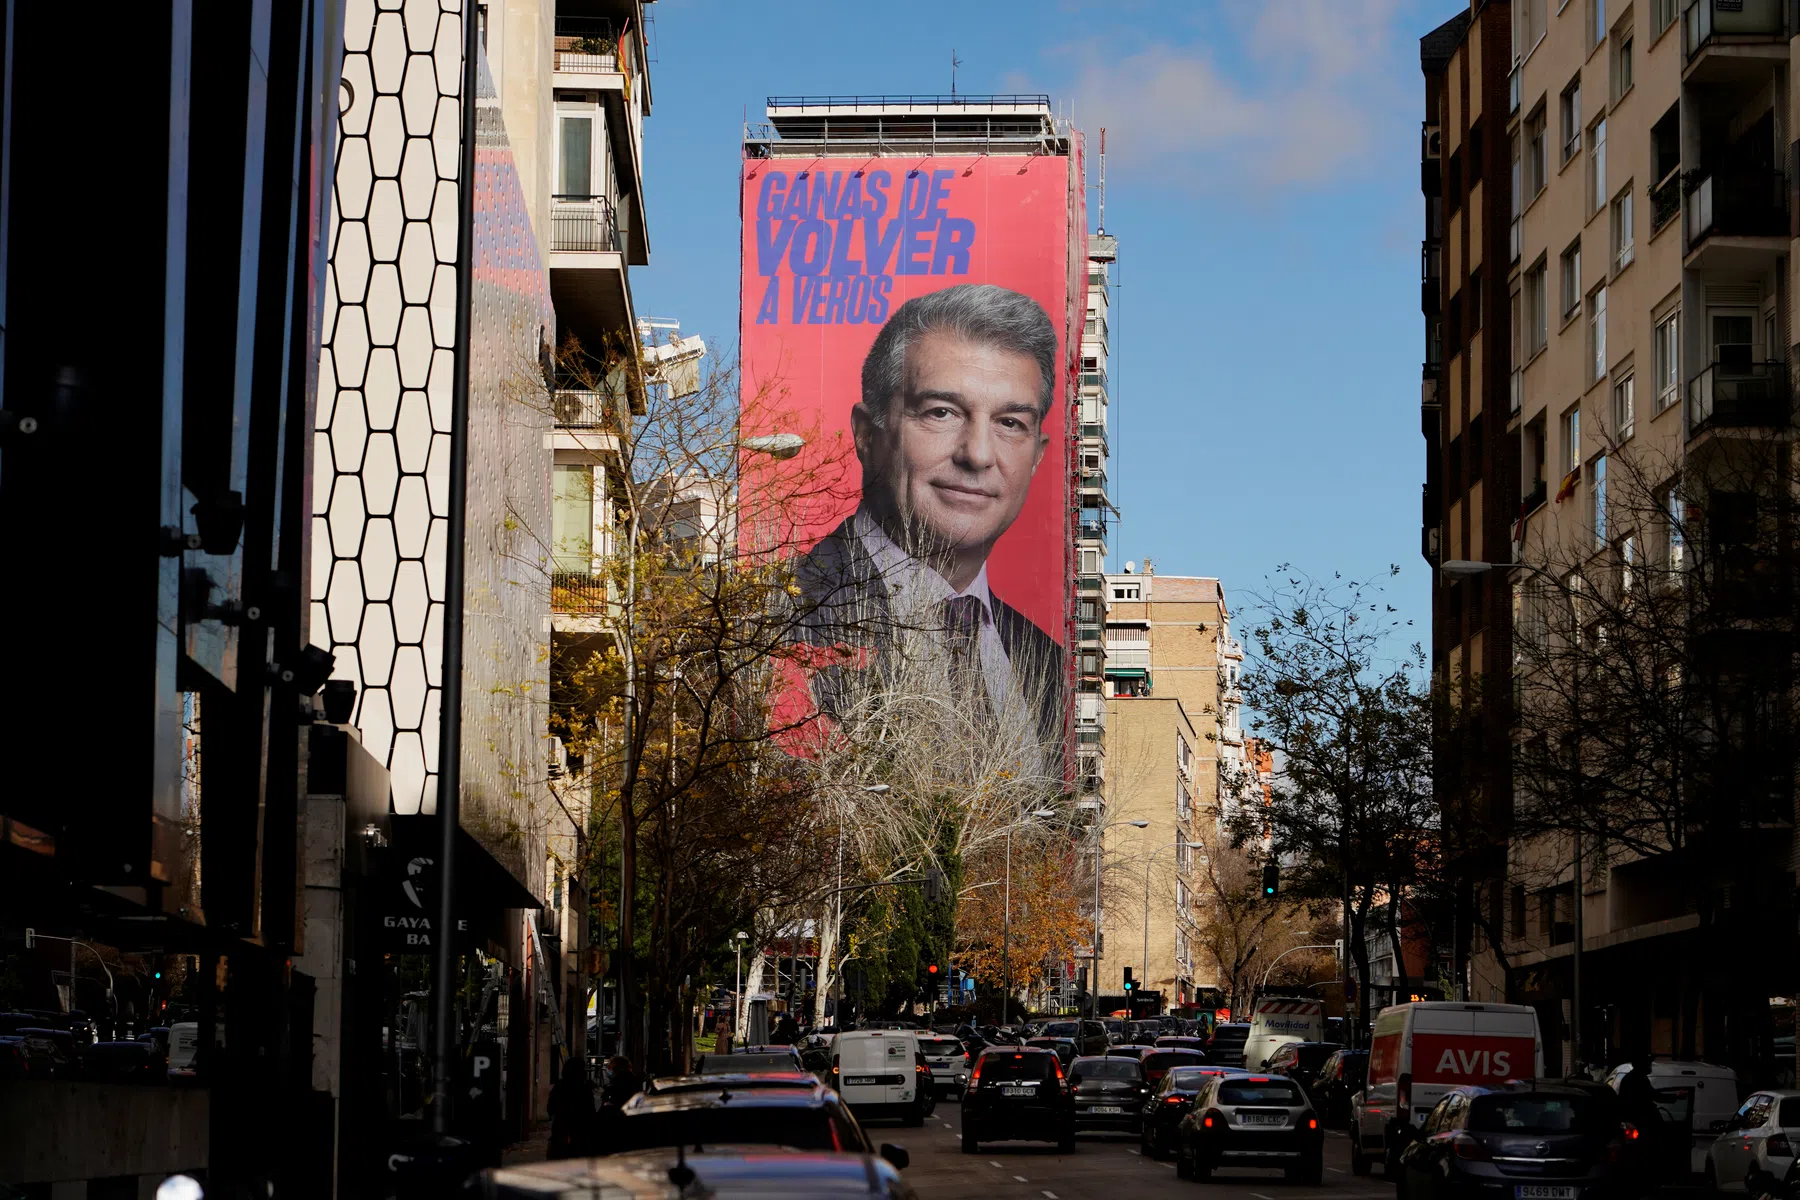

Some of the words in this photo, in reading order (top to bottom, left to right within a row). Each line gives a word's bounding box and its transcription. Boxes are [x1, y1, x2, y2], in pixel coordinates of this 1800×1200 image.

[757, 170, 891, 220] GANAS
[897, 170, 955, 219] DE
[756, 217, 976, 276] VOLVER
[756, 276, 778, 324] A
[792, 275, 893, 324] VEROS
[1265, 1019, 1310, 1030] Movilidad
[473, 1056, 491, 1078] P
[1435, 1048, 1512, 1077] AVIS
[1247, 1115, 1265, 1123] 8180
[1267, 1115, 1281, 1123] CXC
[1523, 1187, 1549, 1197] 9469
[1552, 1187, 1571, 1197] DMT
